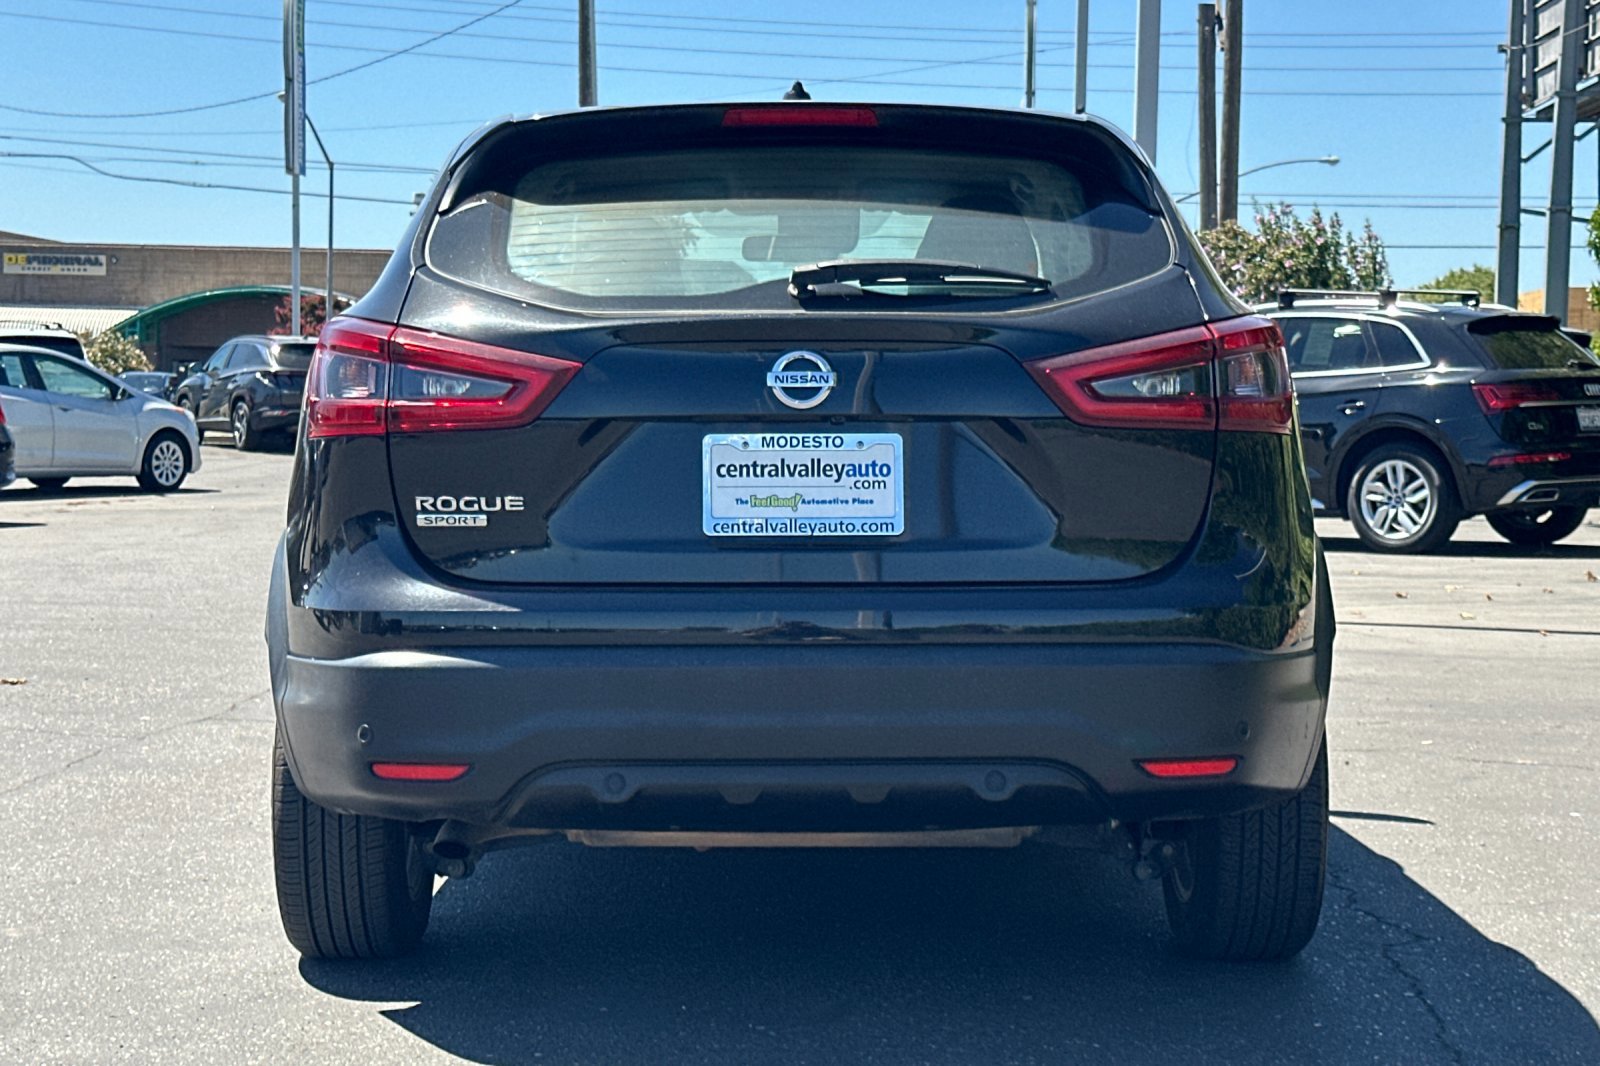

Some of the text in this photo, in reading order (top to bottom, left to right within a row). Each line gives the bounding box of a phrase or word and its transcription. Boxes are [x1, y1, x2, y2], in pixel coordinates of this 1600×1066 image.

[774, 374, 829, 384] NISSAN
[761, 435, 844, 449] MODESTO
[716, 458, 891, 483] centralvalleyauto
[849, 479, 887, 490] .com
[415, 496, 525, 512] ROGUE
[735, 497, 749, 505] The
[801, 497, 849, 505] Automotive
[852, 497, 874, 505] Place
[423, 516, 480, 525] SPORT
[713, 518, 895, 536] centralvalleyauto.com
